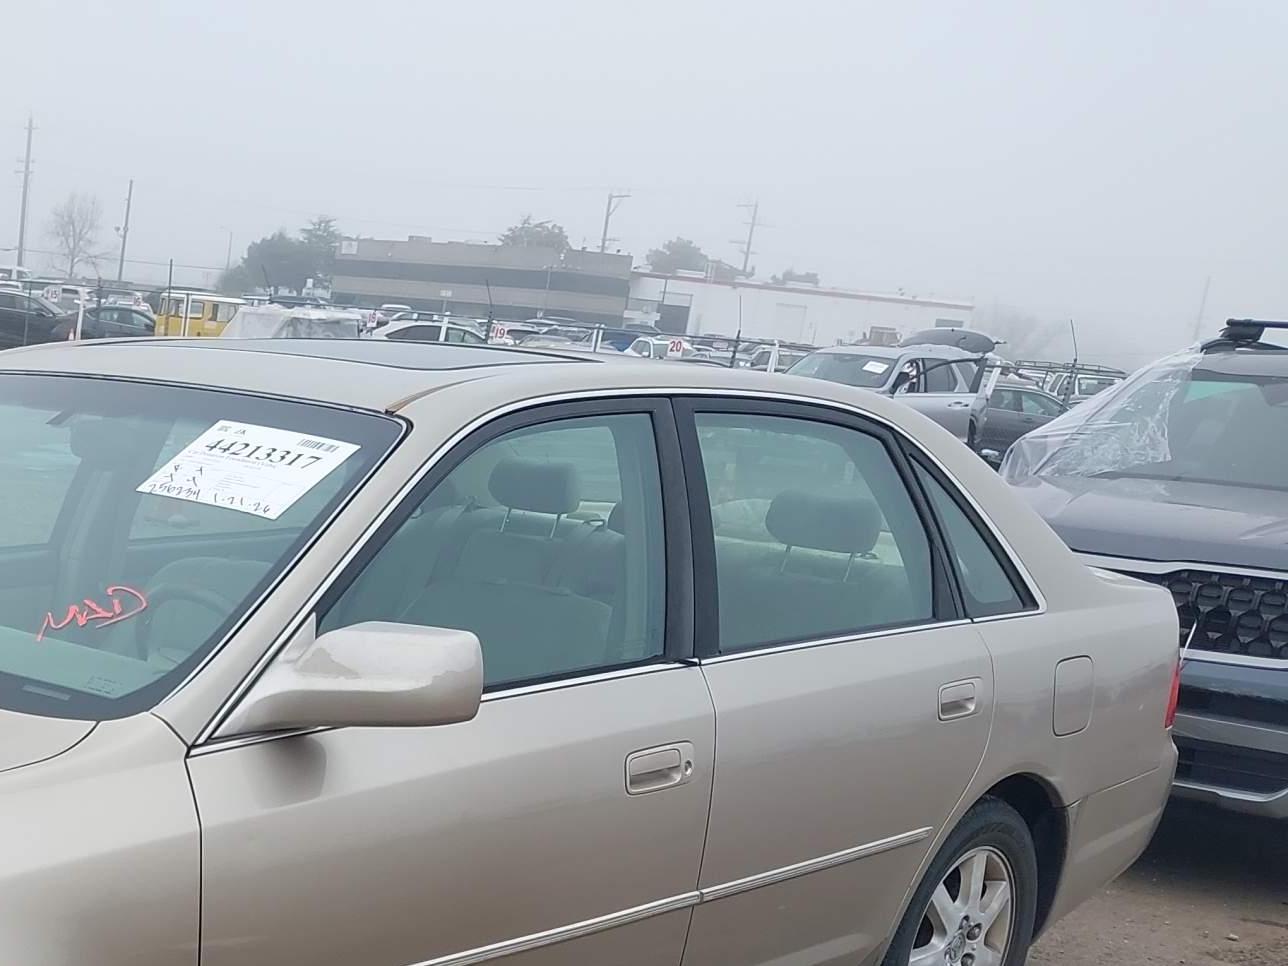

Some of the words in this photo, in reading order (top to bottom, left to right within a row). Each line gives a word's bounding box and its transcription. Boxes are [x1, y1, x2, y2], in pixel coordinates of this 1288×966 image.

[495, 327, 506, 338] 19
[669, 340, 682, 352] 20
[205, 439, 322, 469] 44213317
